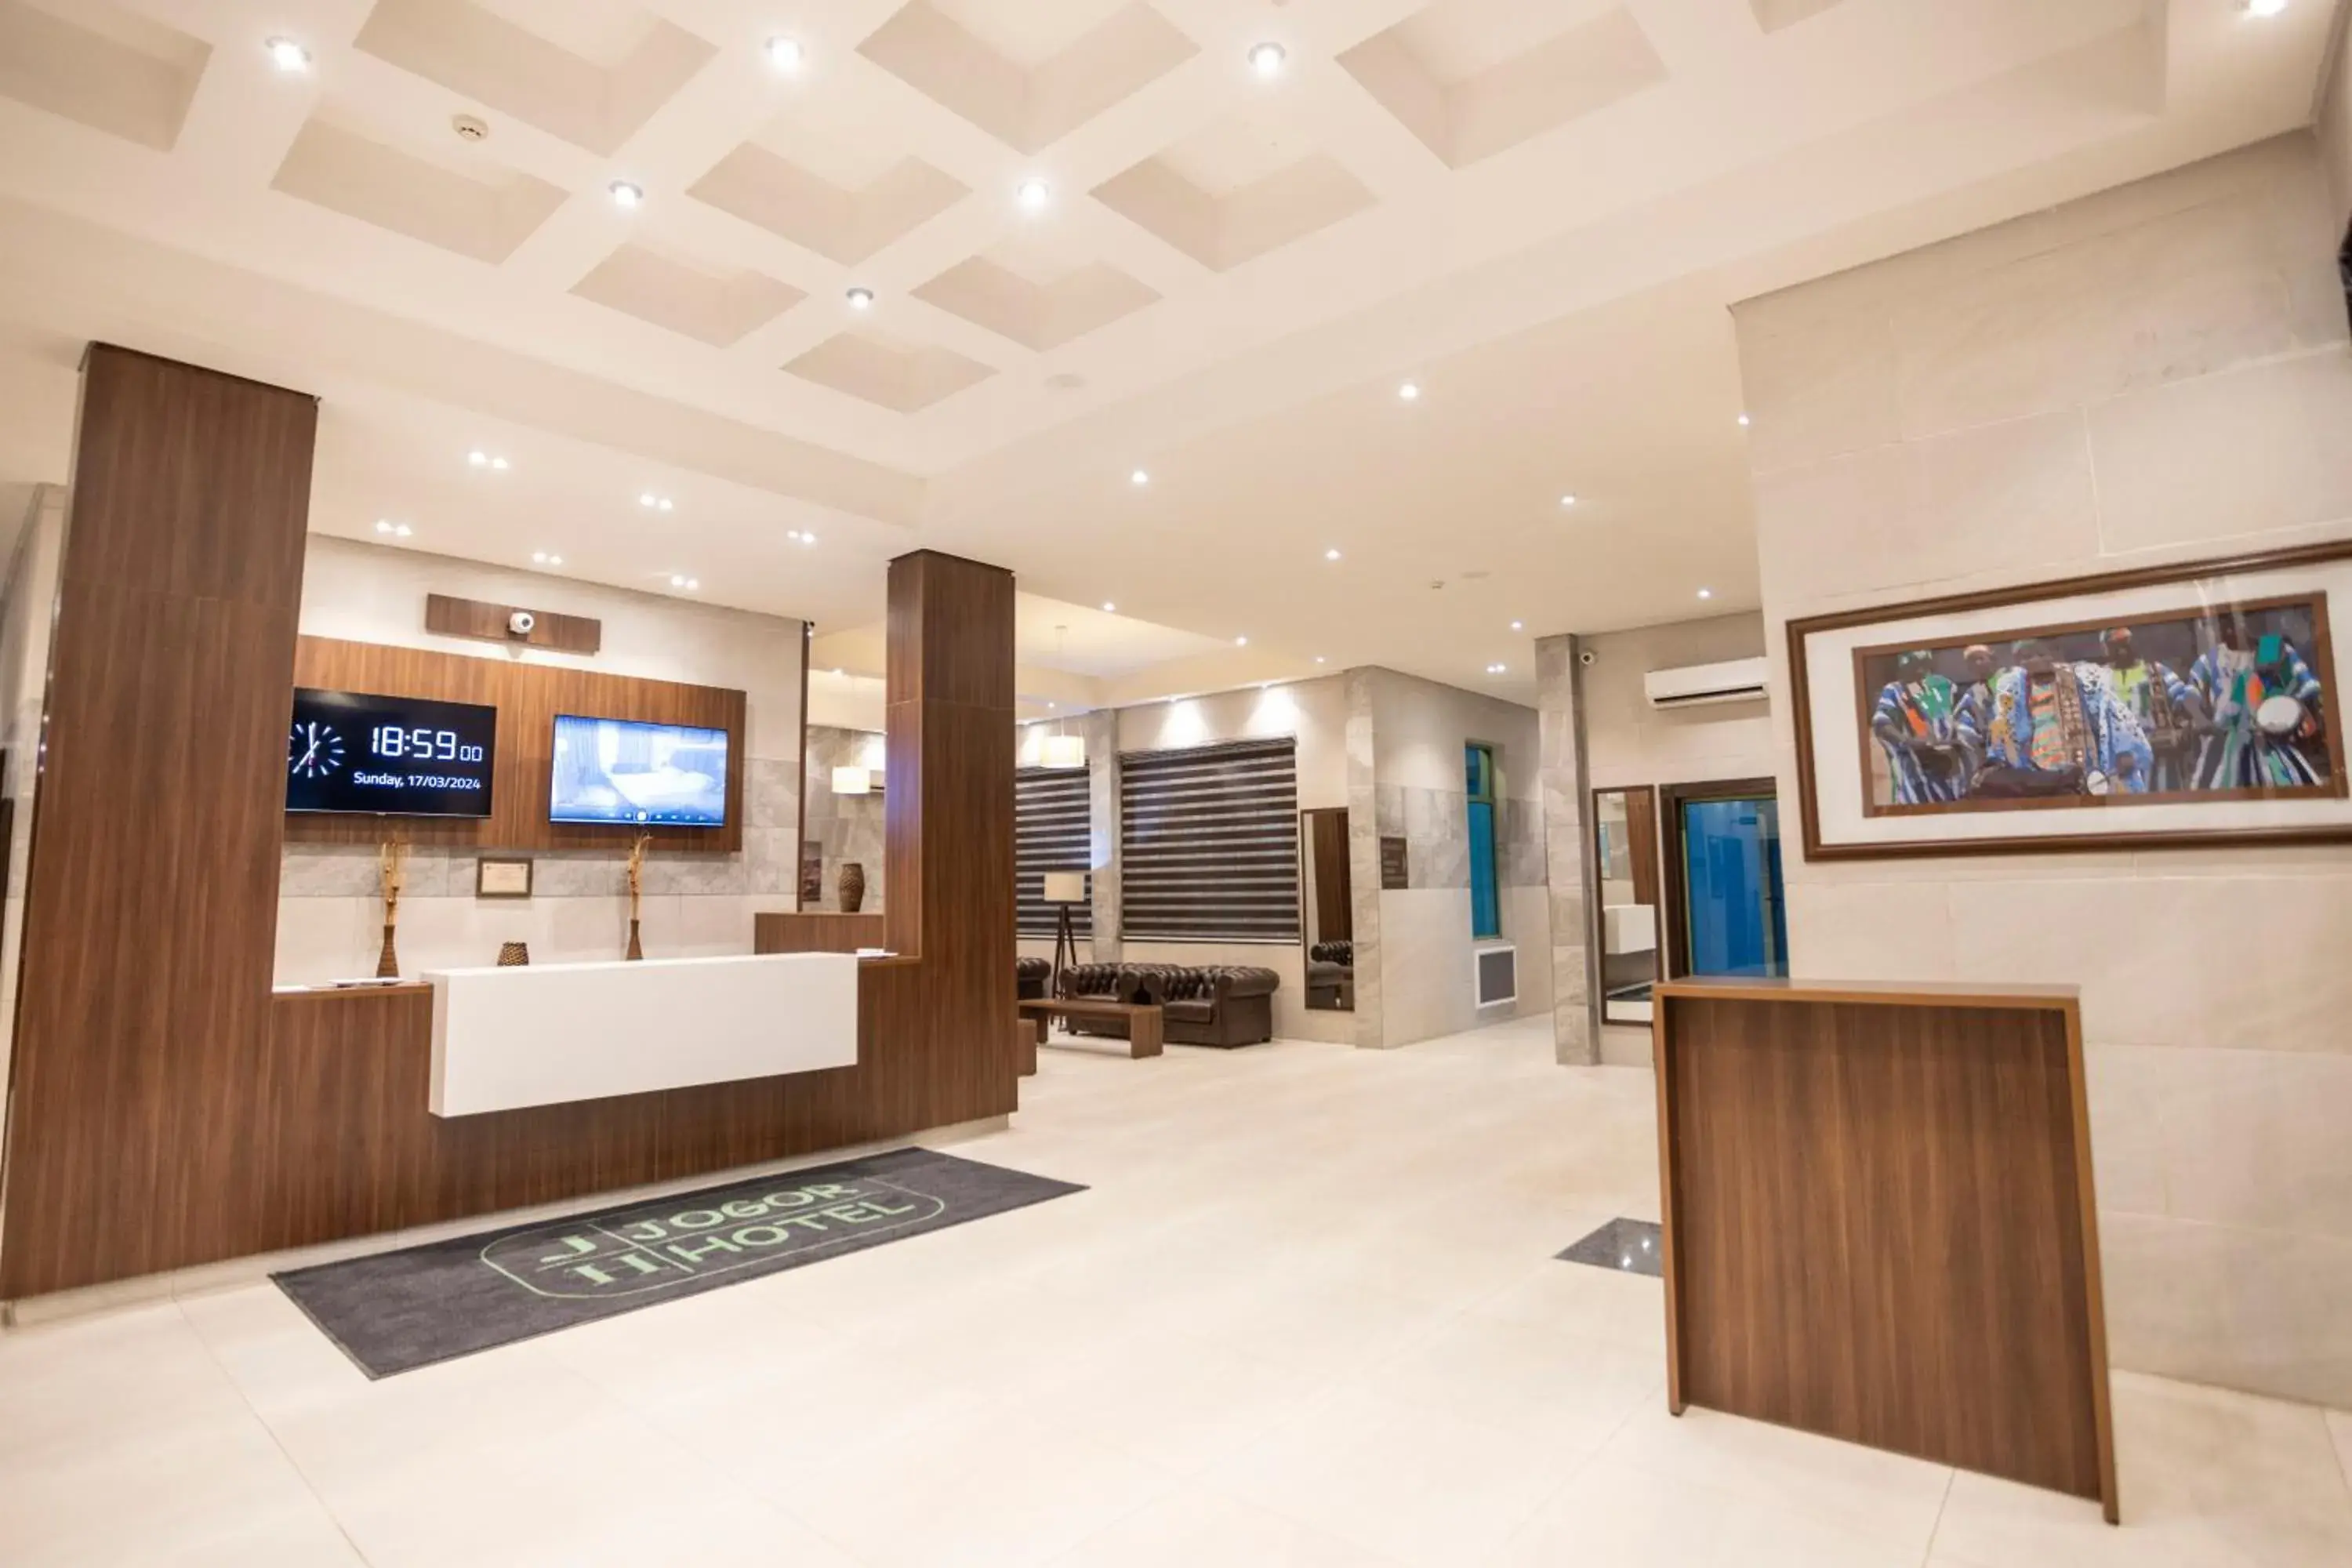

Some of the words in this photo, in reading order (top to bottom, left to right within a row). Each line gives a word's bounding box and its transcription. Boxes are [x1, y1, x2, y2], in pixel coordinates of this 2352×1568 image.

[372, 727, 456, 760] 18:59
[460, 746, 482, 761] 00
[354, 771, 405, 788] Sunday,
[408, 775, 481, 789] 17/03/2024
[622, 1183, 859, 1240] JOGOR
[667, 1201, 916, 1263] HOTEL
